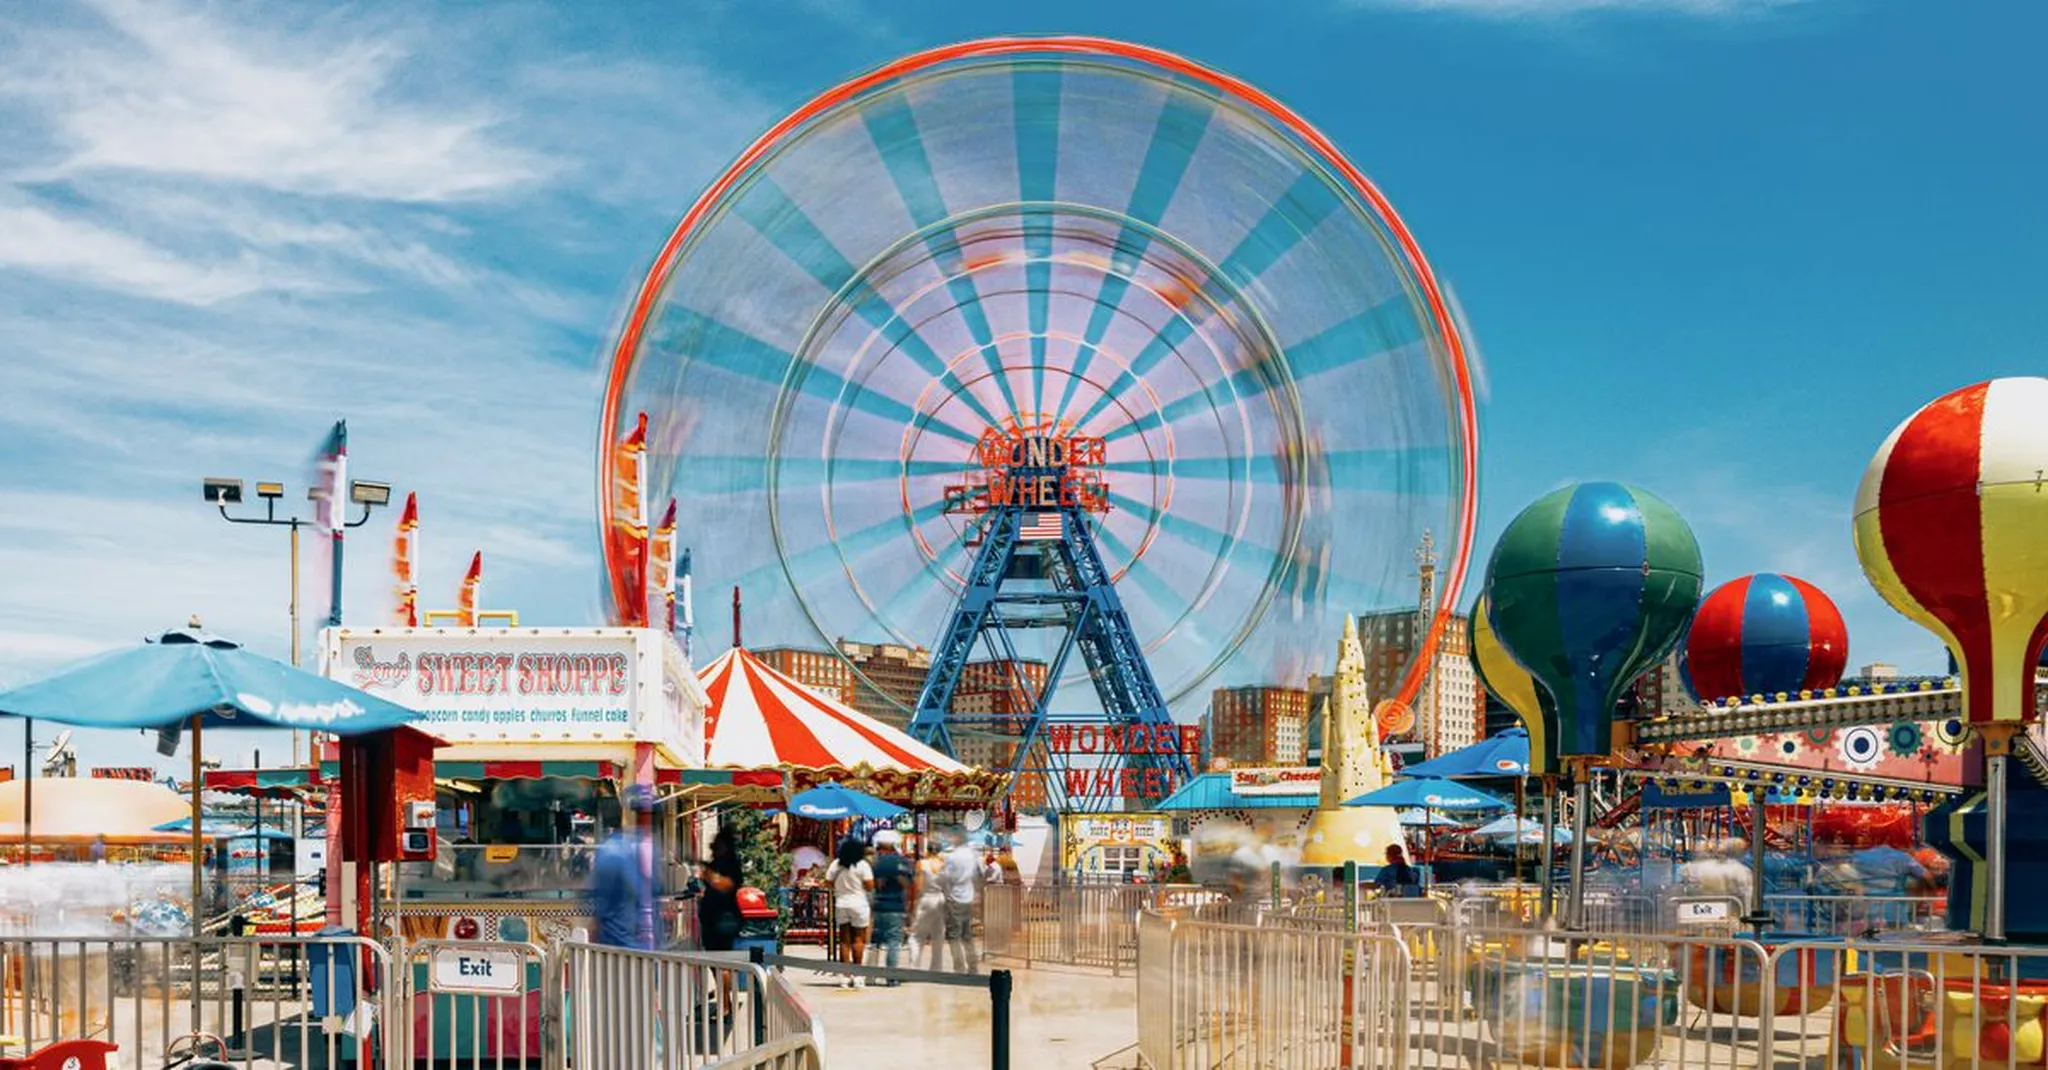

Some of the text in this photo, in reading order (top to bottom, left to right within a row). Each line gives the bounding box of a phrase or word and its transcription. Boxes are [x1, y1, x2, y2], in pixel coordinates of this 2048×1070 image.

[977, 437, 1106, 468] WONDER
[988, 475, 1099, 508] WHEEL
[416, 652, 513, 695] SWEET
[517, 652, 628, 695] SHOPPE
[461, 706, 491, 724] candy
[493, 707, 525, 724] apples
[530, 707, 567, 723] churros
[572, 707, 603, 722] funnel
[605, 708, 628, 722] cake
[1050, 724, 1201, 754] WONDER
[1236, 771, 1321, 784] Say Cheese
[1692, 904, 1712, 914] Exit
[459, 956, 492, 976] Exit
